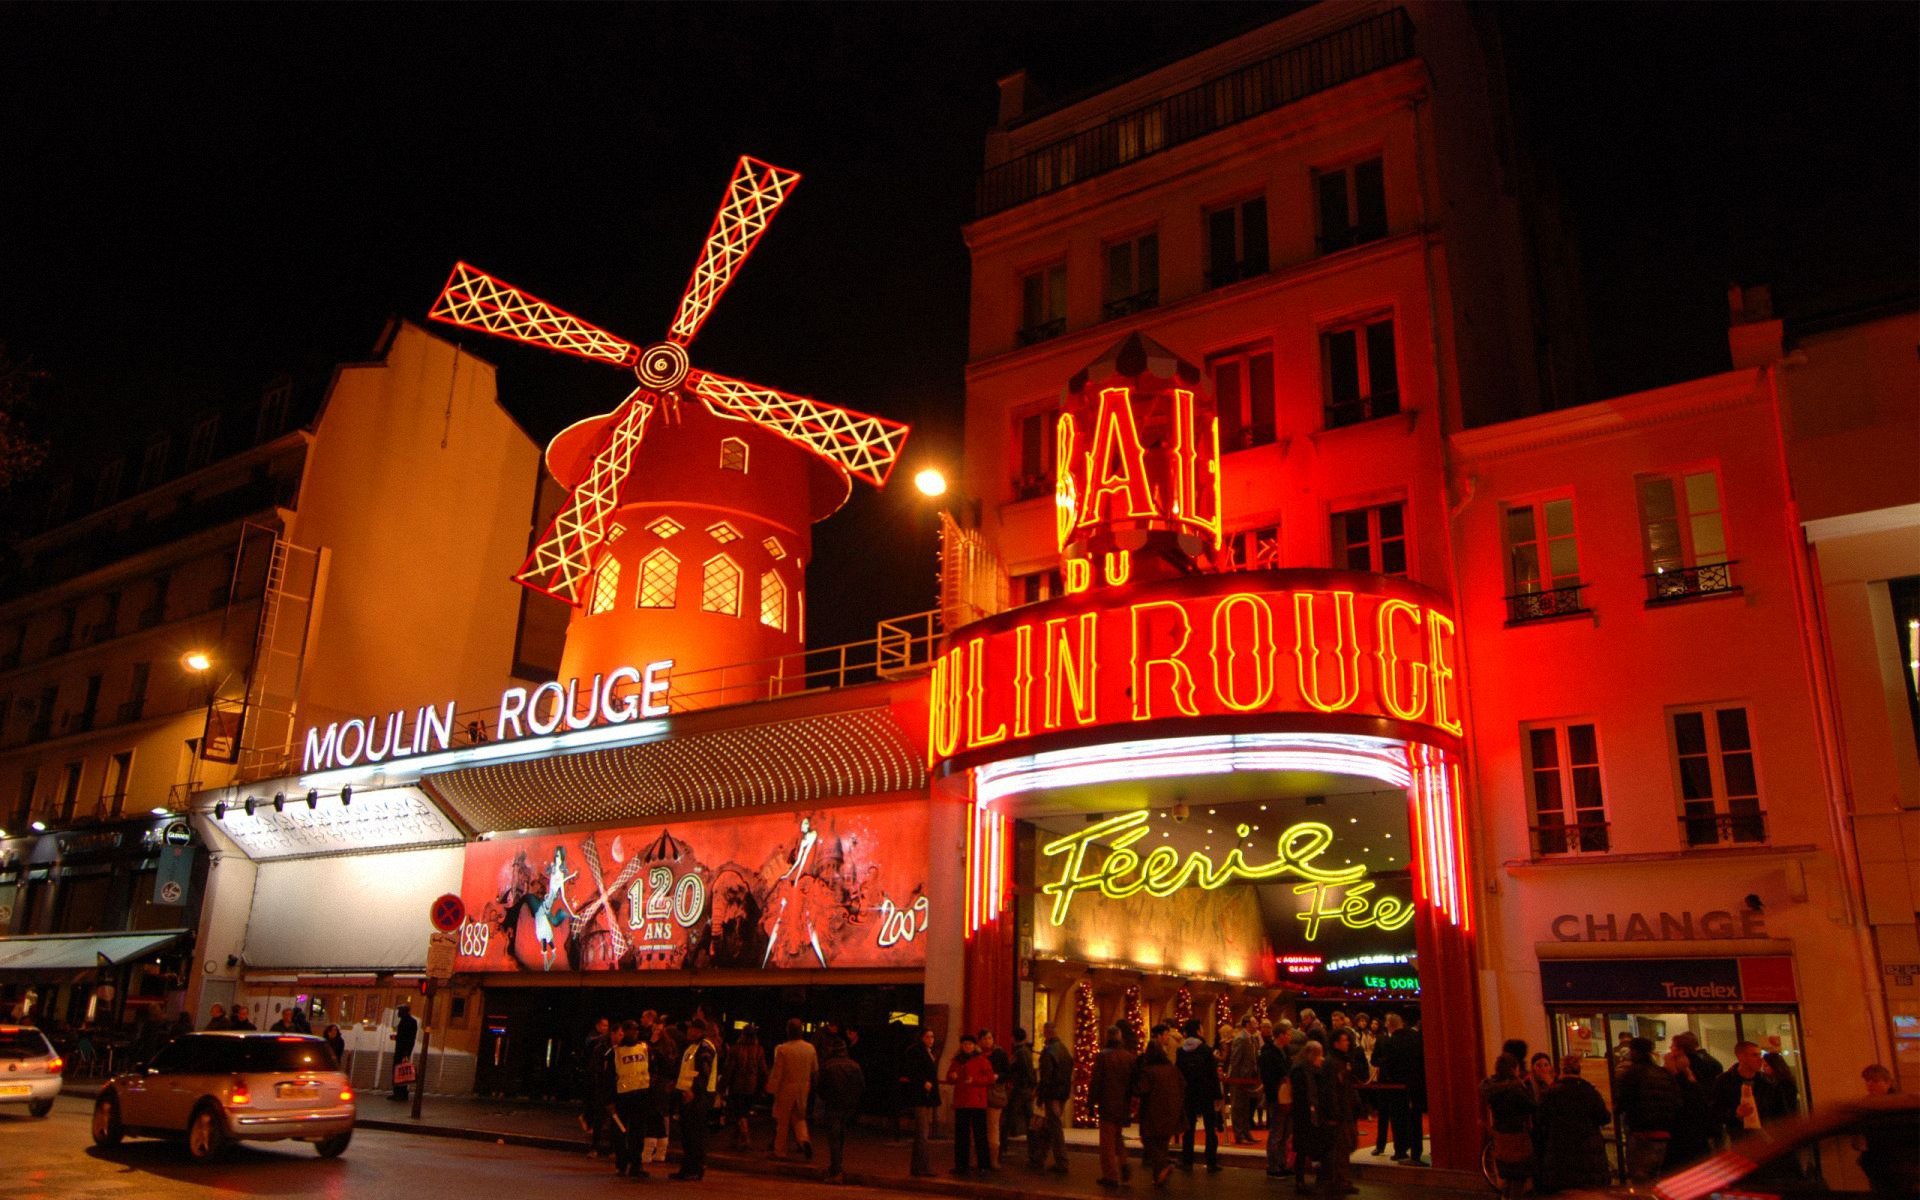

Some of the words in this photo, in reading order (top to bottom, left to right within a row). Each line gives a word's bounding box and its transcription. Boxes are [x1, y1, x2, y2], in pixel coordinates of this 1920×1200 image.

[1057, 388, 1222, 553] BAL
[1067, 550, 1129, 593] DU
[1130, 593, 1463, 737] ROUGE
[302, 700, 455, 772] MOULIN
[497, 658, 676, 739] ROUGE
[1044, 810, 1366, 926] Féerie
[627, 866, 705, 931] 120
[878, 896, 929, 946] 2009
[459, 915, 489, 957] 1889
[643, 922, 672, 940] ANS
[1551, 910, 1768, 942] CHANGE
[1364, 976, 1387, 988] LES
[1661, 980, 1737, 999] Travelex
